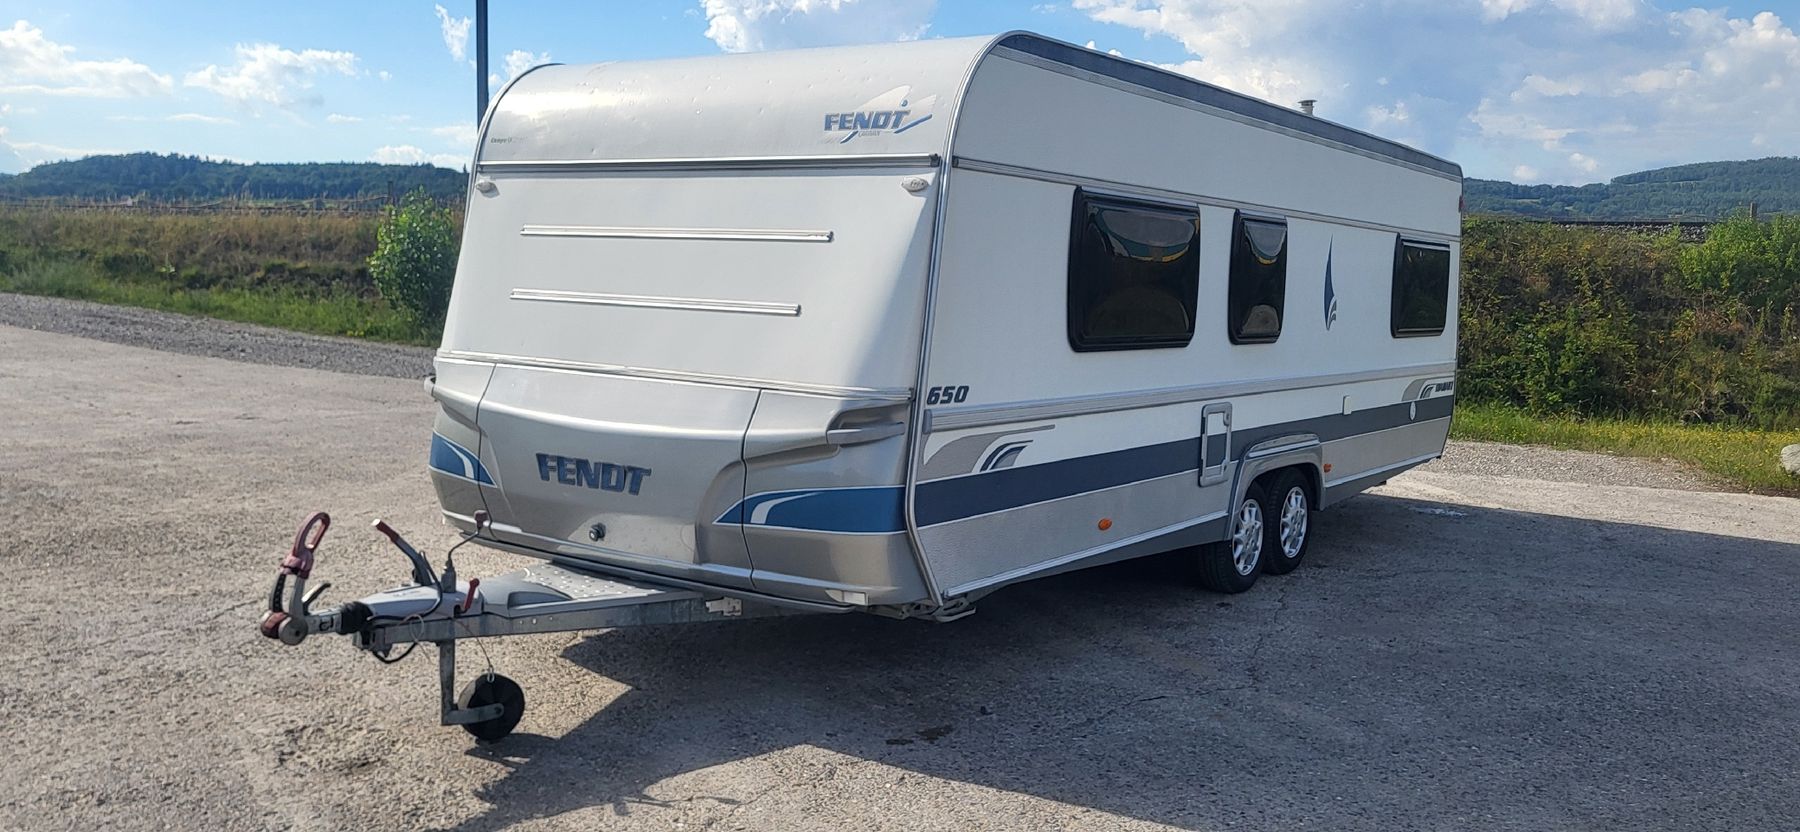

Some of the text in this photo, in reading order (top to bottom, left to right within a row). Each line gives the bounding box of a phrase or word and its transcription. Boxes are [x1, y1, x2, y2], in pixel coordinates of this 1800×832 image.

[823, 109, 911, 131] FENDT
[927, 385, 970, 405] 650
[535, 452, 652, 496] FENDT
